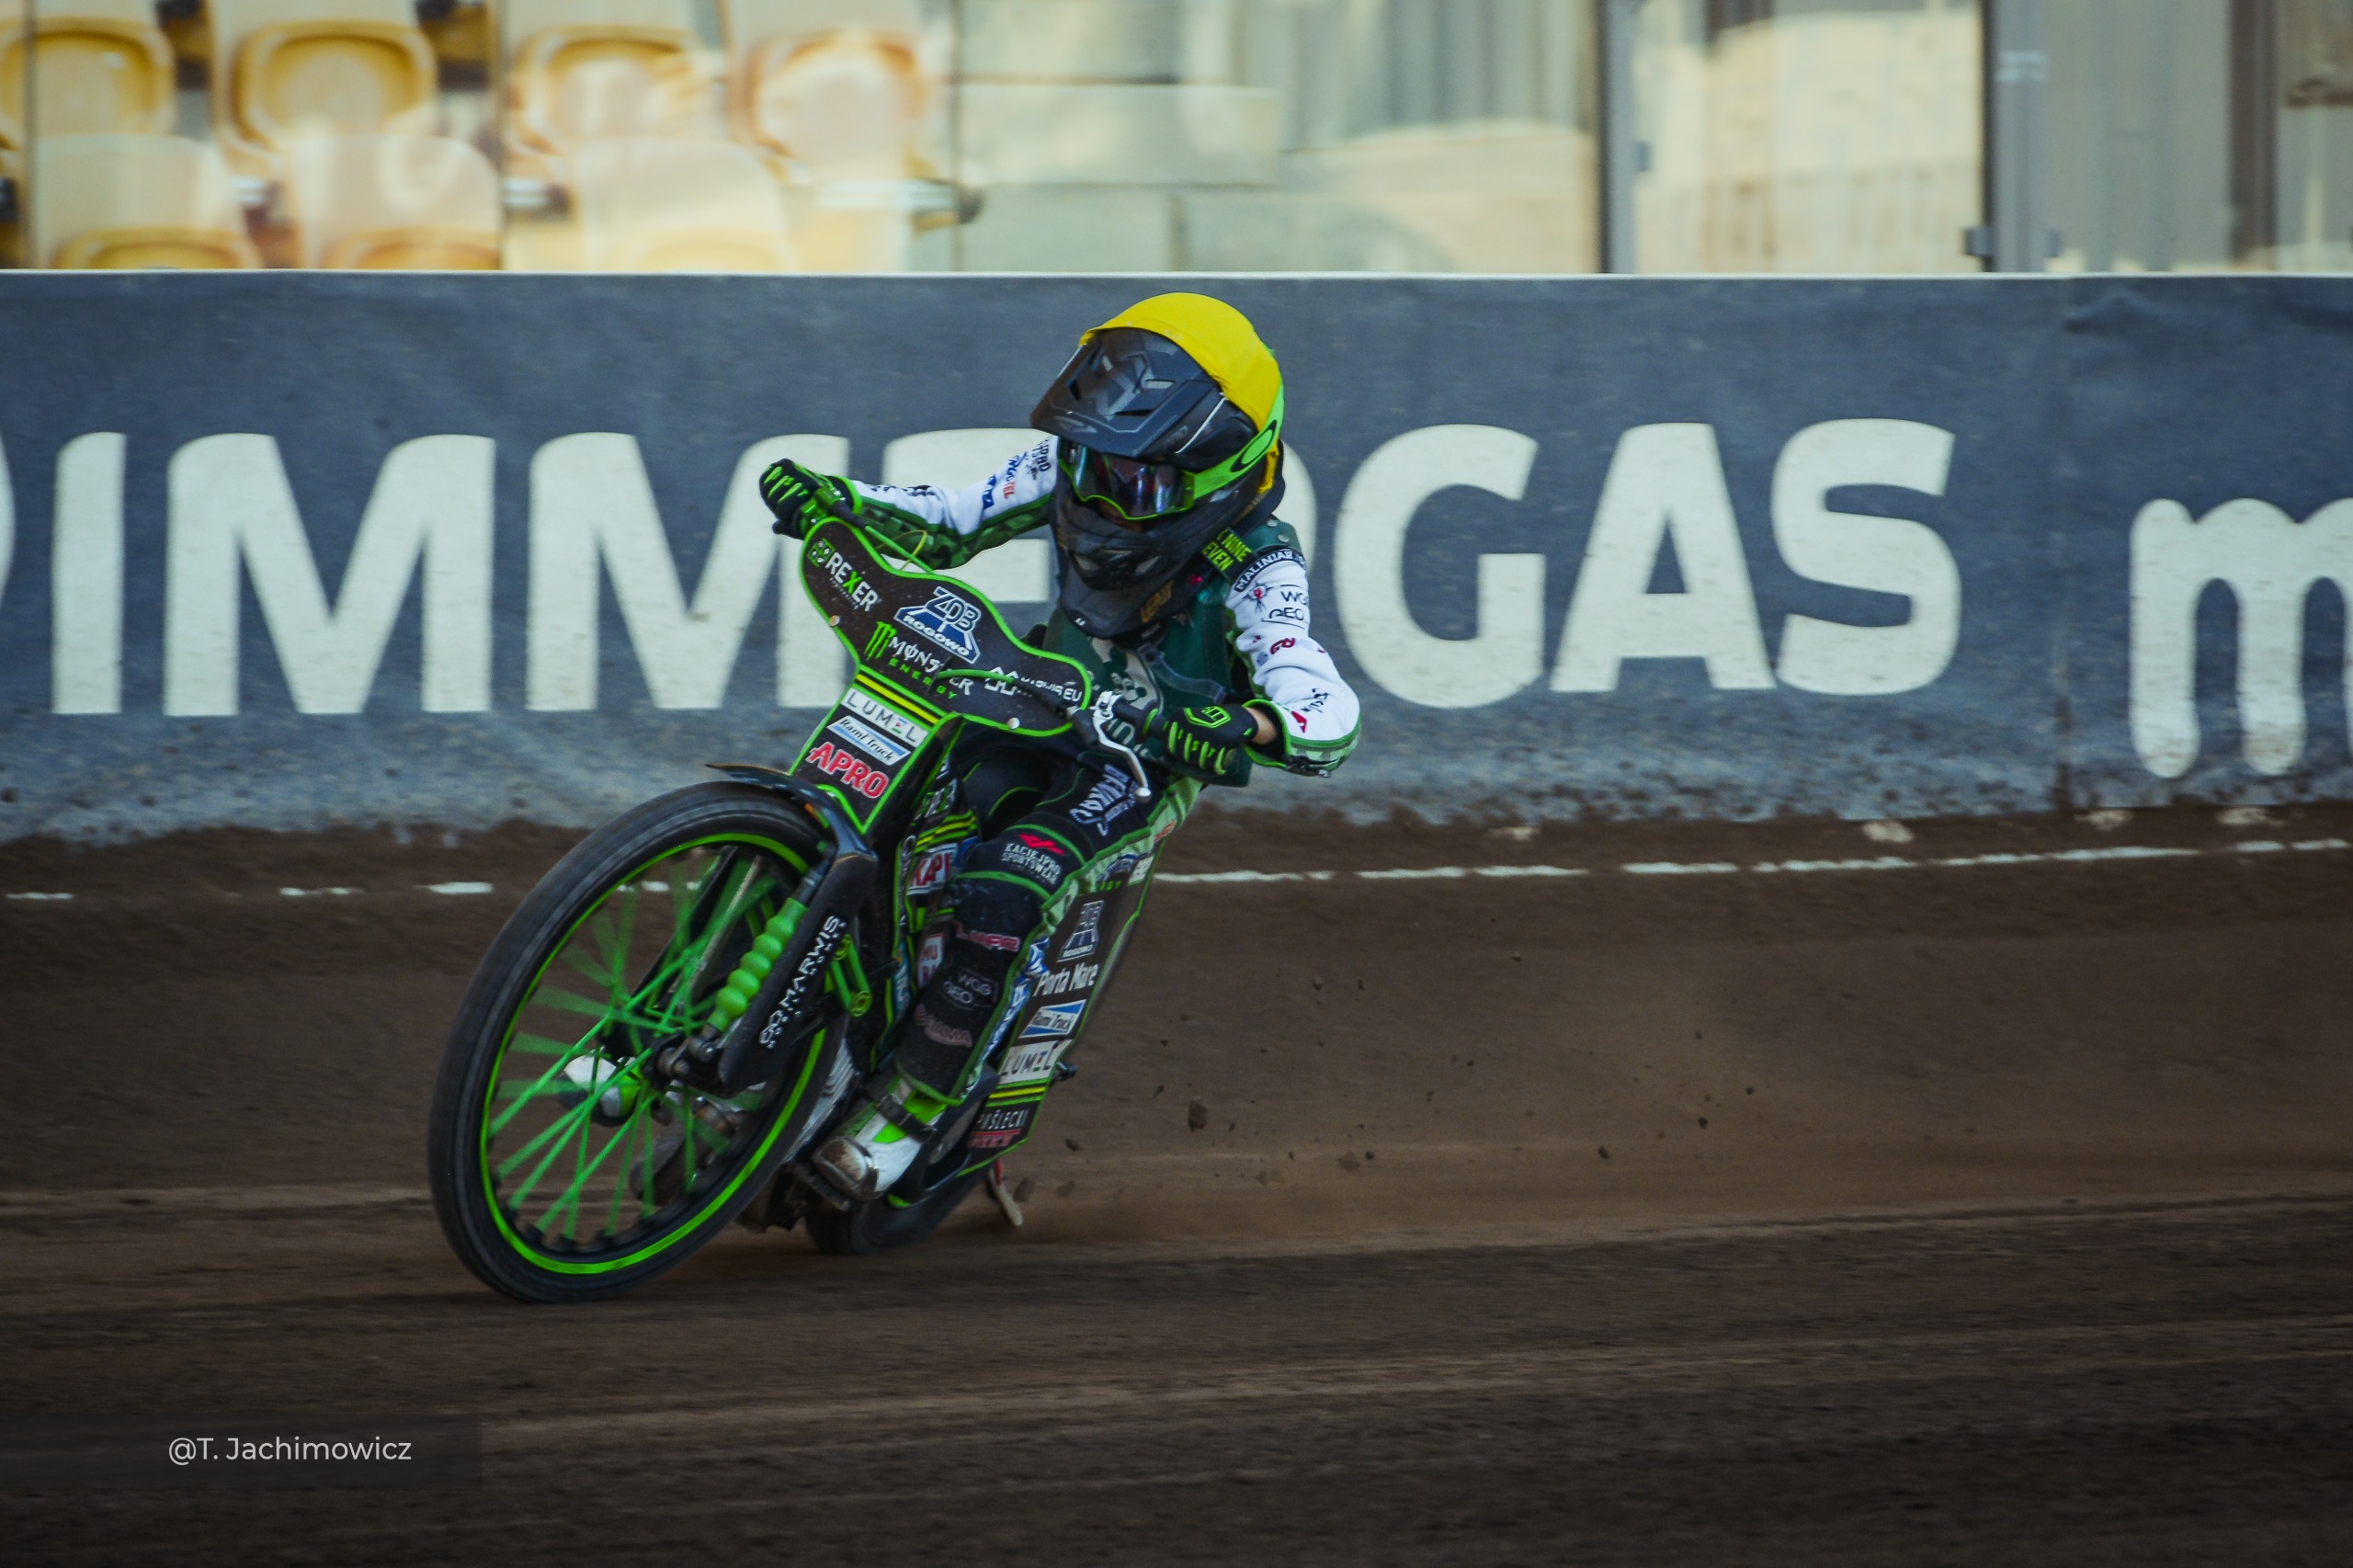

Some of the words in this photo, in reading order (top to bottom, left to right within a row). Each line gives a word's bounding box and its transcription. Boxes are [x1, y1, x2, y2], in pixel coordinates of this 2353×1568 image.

[52, 417, 1962, 716] IMMGAS
[1204, 541, 1233, 571] EVEN
[824, 551, 879, 612] REXER
[903, 615, 970, 656] ROGOWO
[888, 635, 973, 696] MONSER
[889, 657, 958, 699] ENERGY
[805, 741, 890, 799] APRO
[868, 735, 894, 762] Truck
[779, 915, 841, 1008] MARWIS
[1033, 967, 1071, 997] Porta
[1068, 961, 1099, 992] Mare
